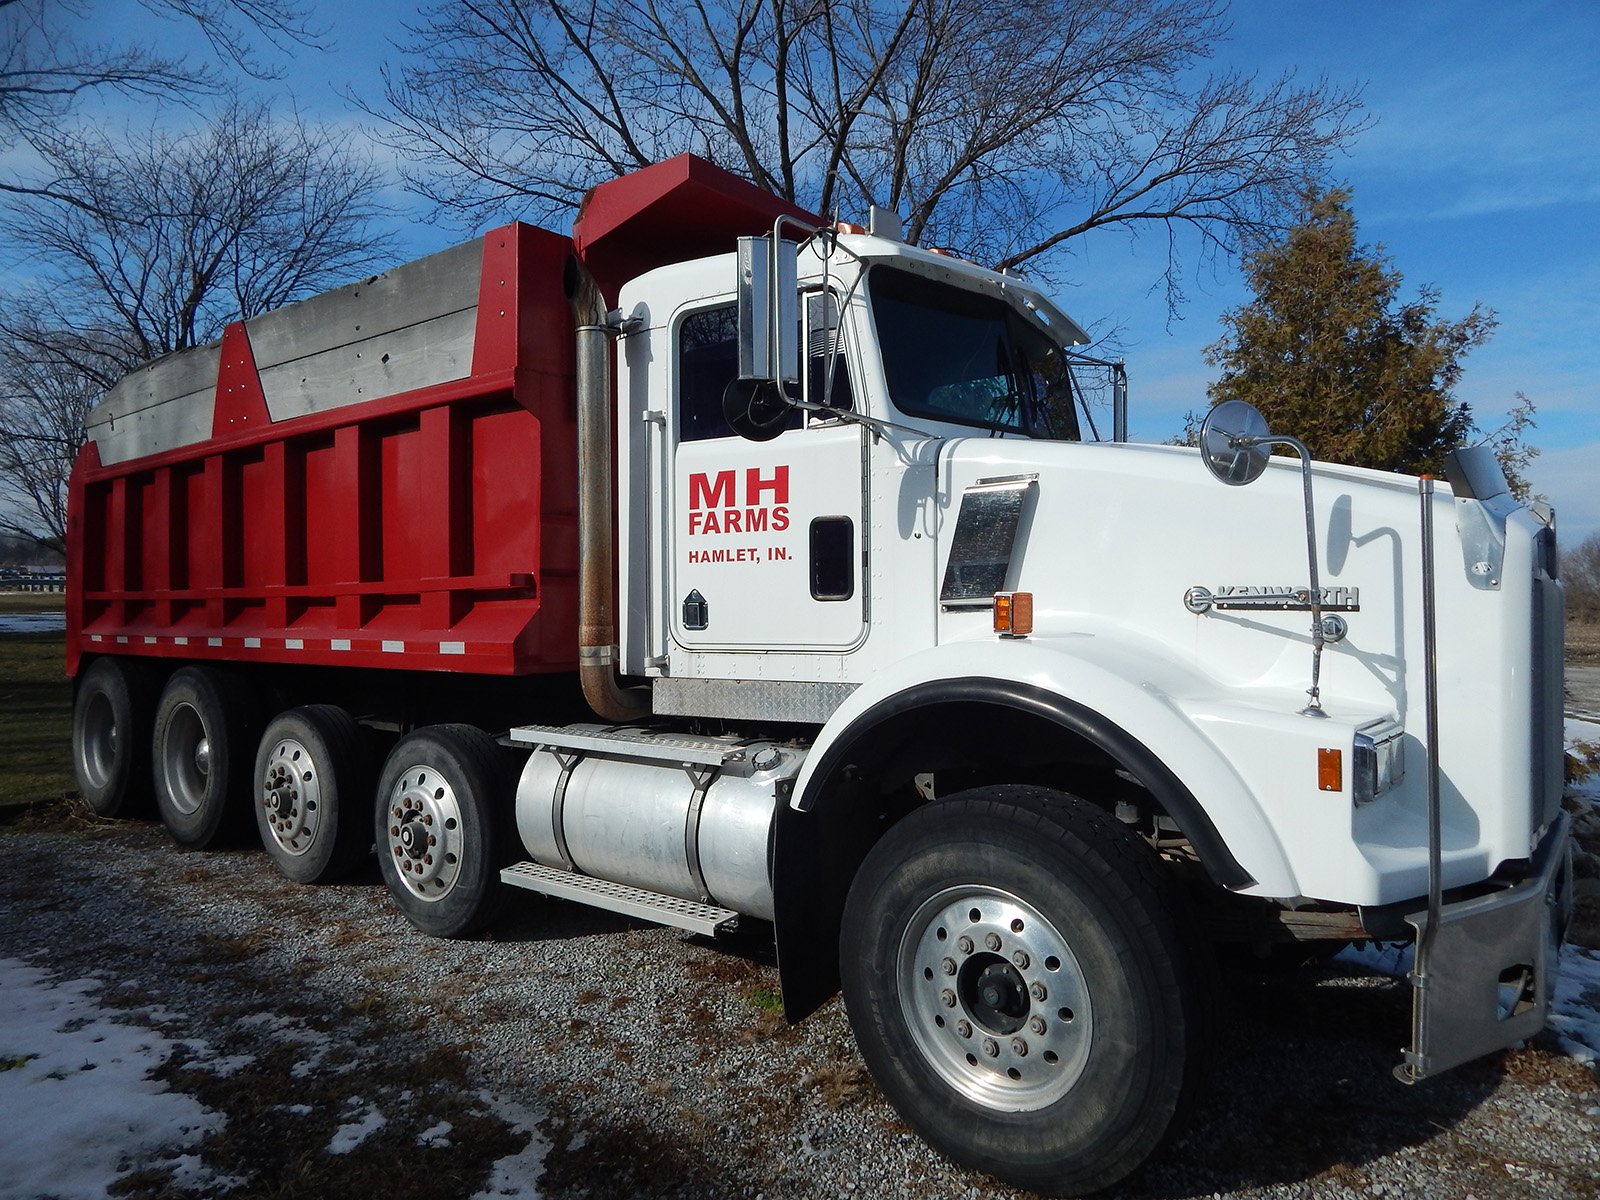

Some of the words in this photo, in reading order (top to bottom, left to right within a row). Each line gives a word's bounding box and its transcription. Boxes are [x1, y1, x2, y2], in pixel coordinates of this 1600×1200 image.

[689, 506, 790, 536] FARMS
[688, 548, 760, 564] HAMLET,
[768, 547, 793, 561] IN.
